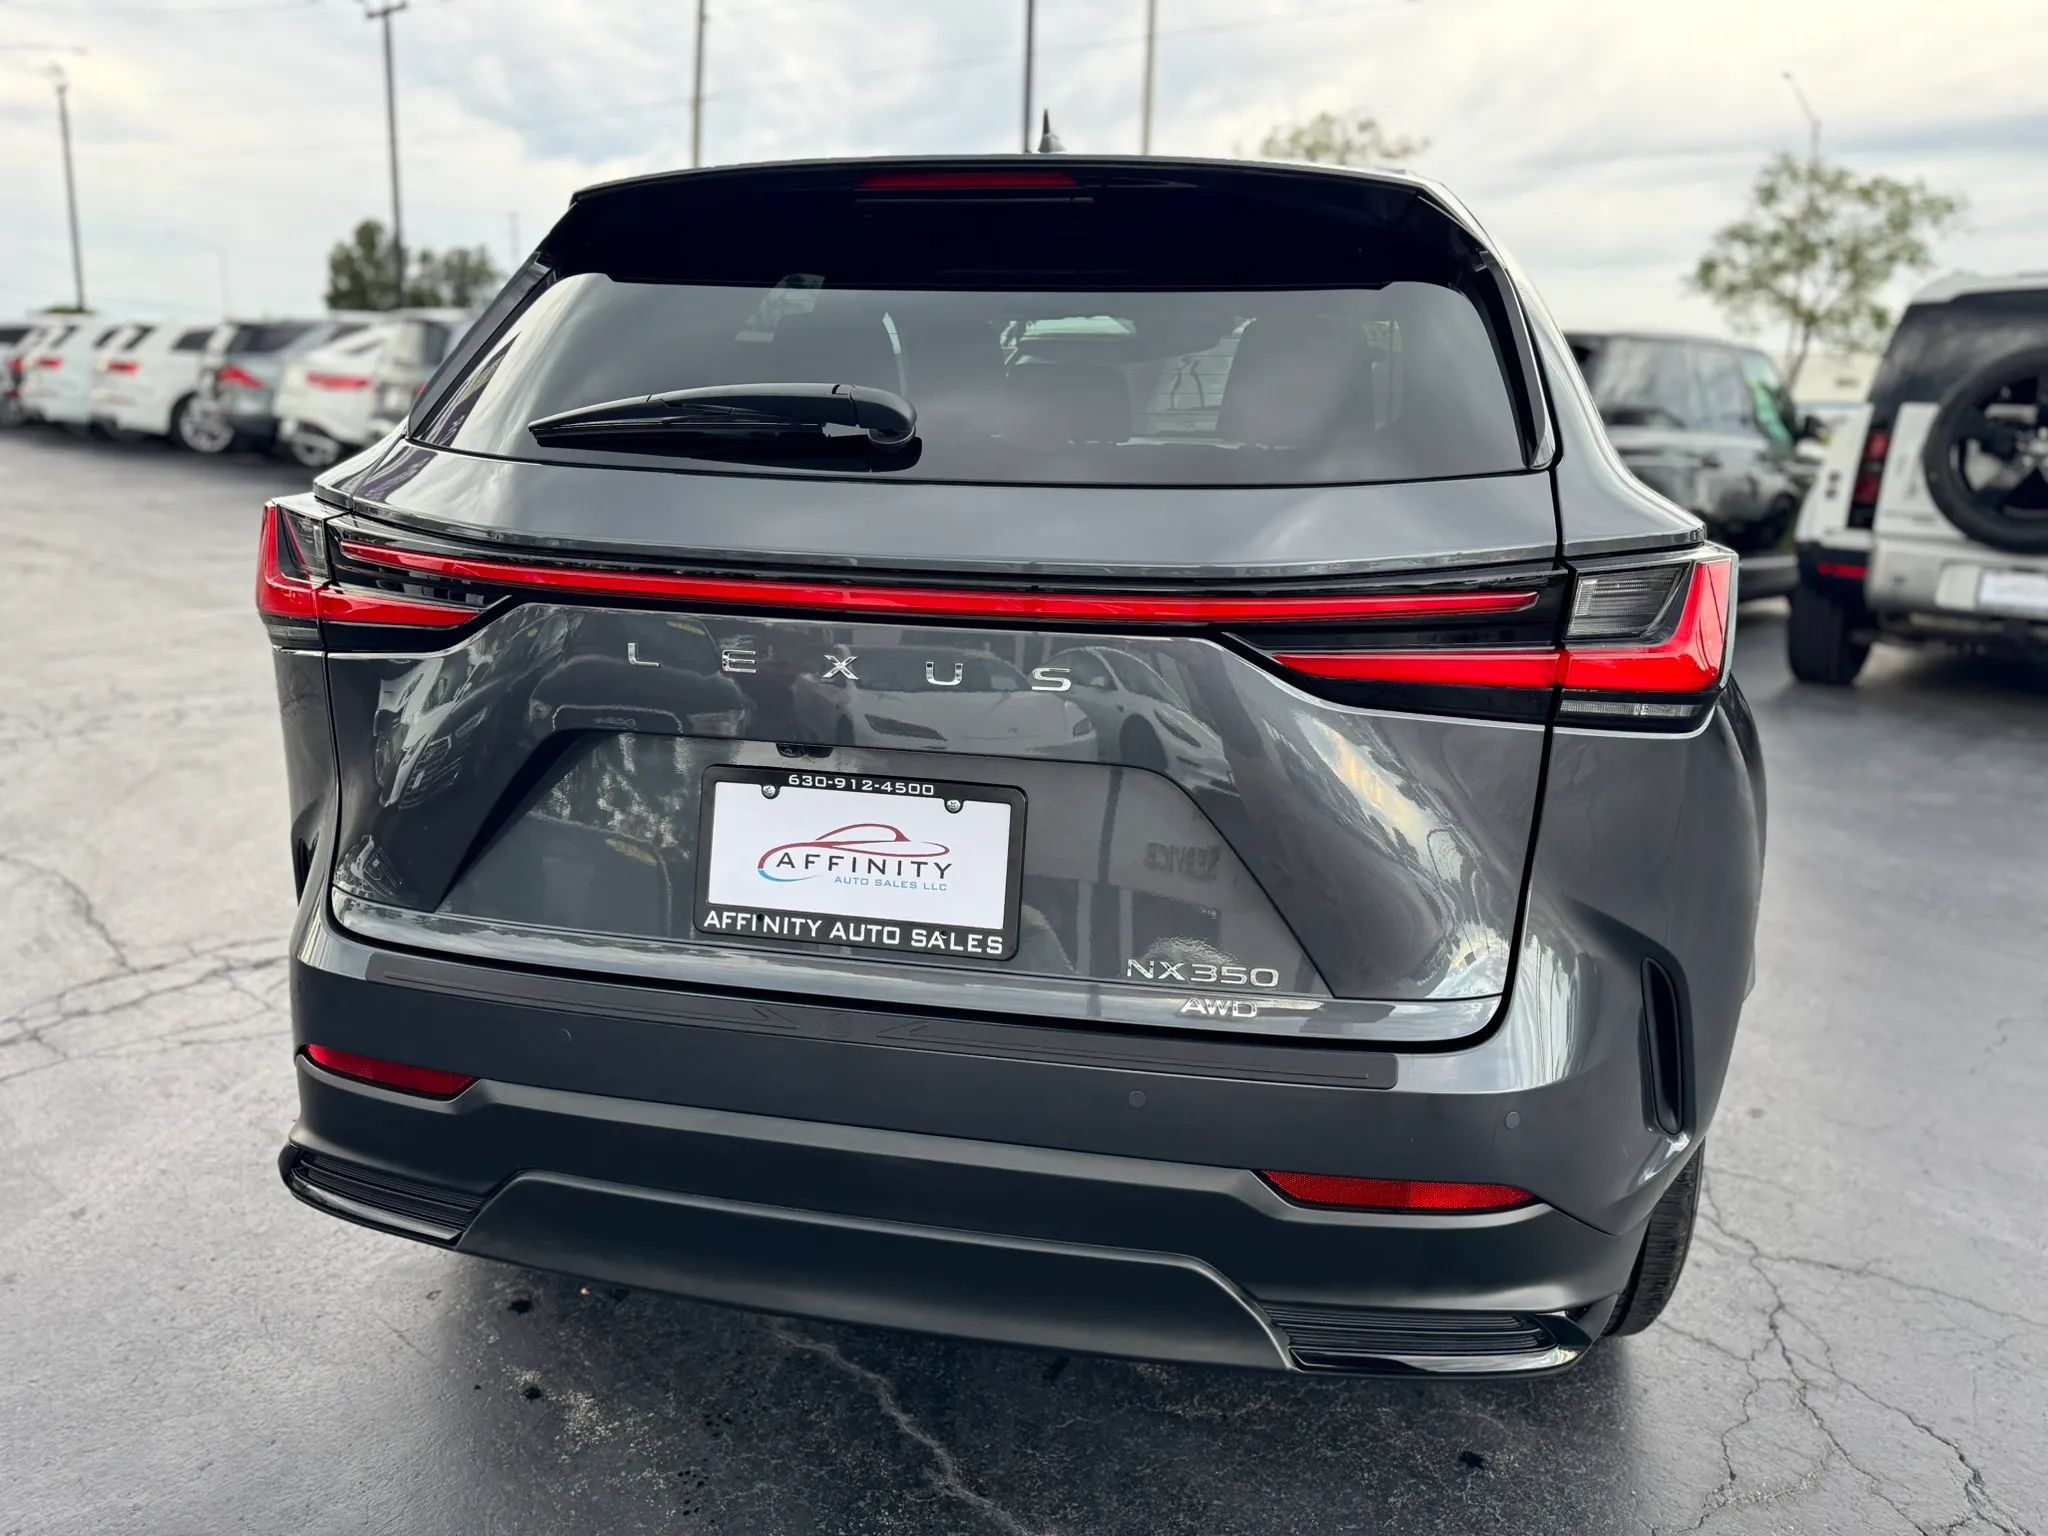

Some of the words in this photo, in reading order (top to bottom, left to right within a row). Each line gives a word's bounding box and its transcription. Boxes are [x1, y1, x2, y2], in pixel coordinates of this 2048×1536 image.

[627, 642, 1072, 692] LEXUS
[788, 774, 934, 795] 630-912-4500
[776, 852, 952, 879] AFFINITY
[834, 875, 869, 886] AUTO
[874, 878, 917, 889] SALES
[923, 882, 947, 891] LLC
[704, 910, 822, 937] AFFINITY
[829, 921, 900, 945] AUTO
[910, 929, 1003, 955] SALES
[1126, 958, 1280, 988] NX350
[1180, 996, 1258, 1018] AWD
